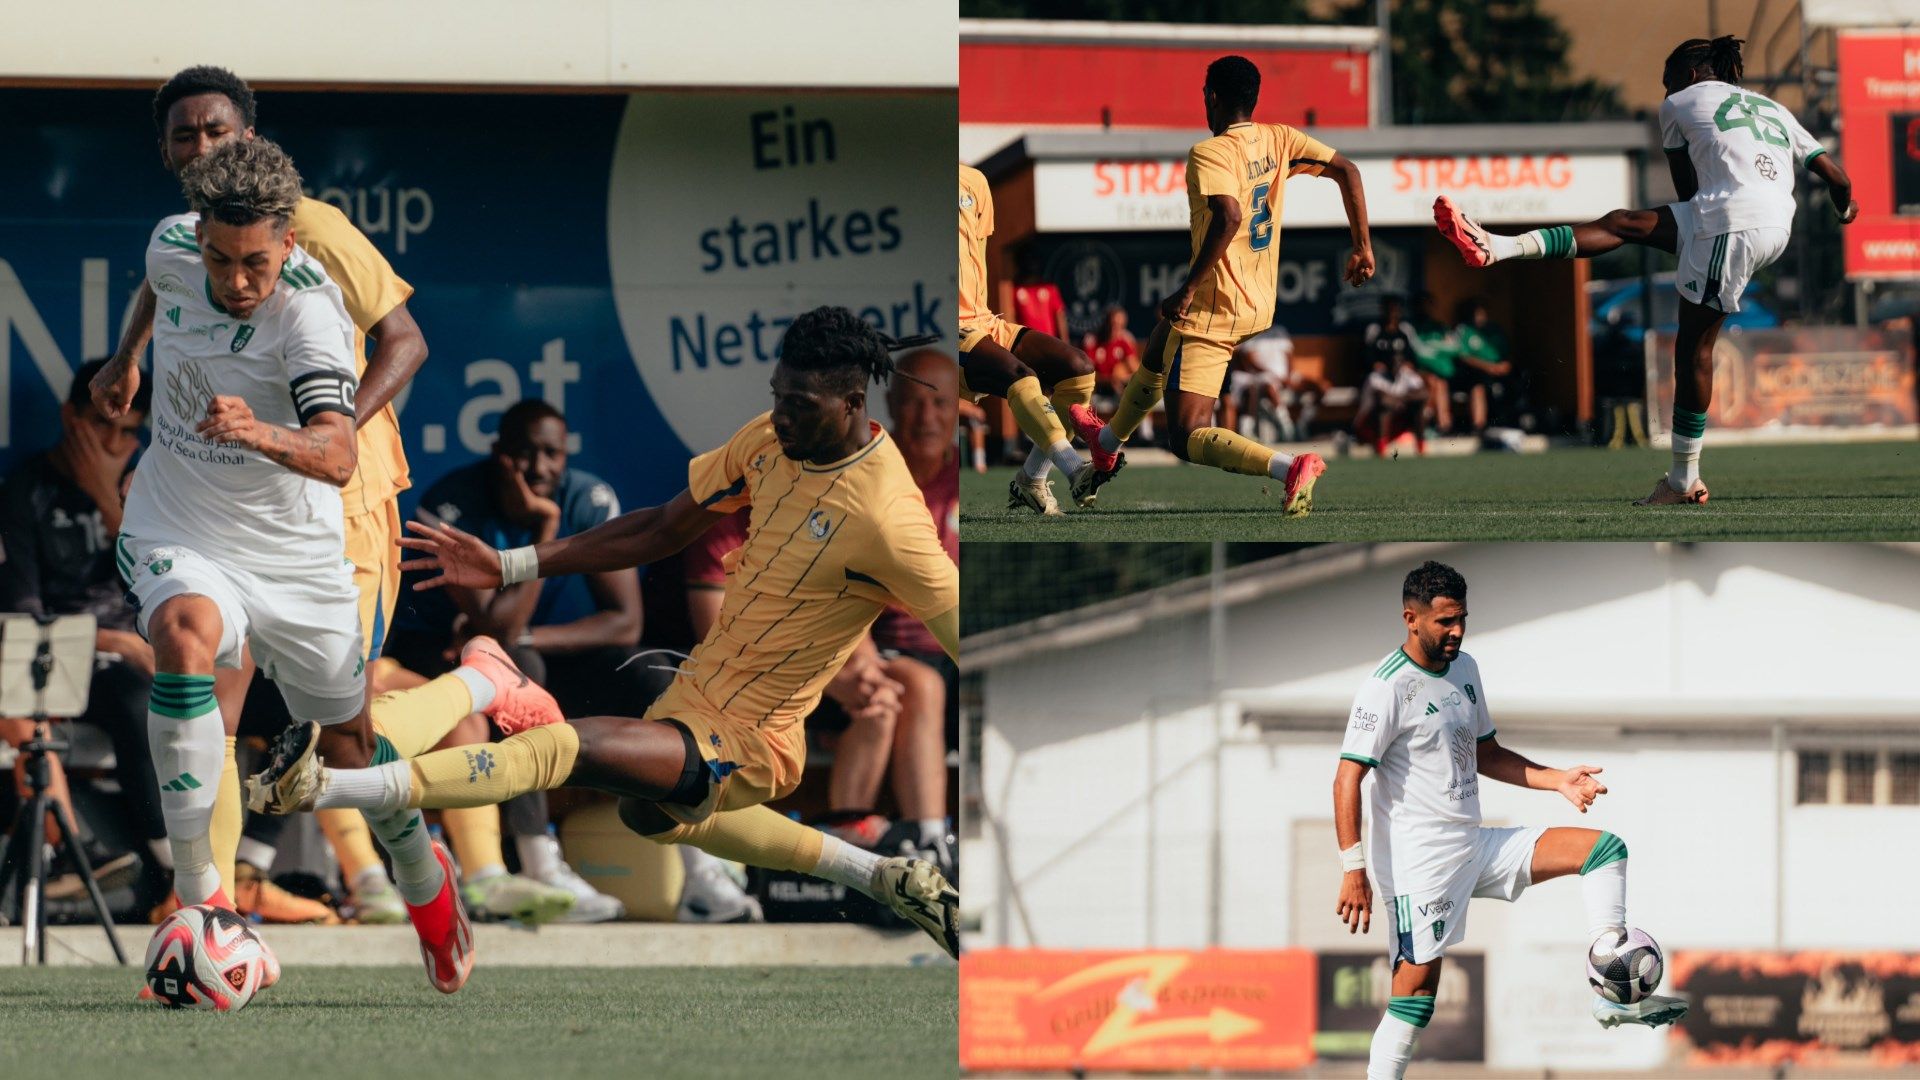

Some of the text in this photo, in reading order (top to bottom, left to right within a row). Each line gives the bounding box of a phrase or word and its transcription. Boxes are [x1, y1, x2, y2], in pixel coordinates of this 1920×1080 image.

[750, 105, 836, 170] Ein
[1713, 92, 1790, 149] 45
[1094, 159, 1187, 196] STRA
[1393, 153, 1574, 192] STRABAG
[302, 186, 434, 254] oup
[700, 198, 903, 273] starkes
[1248, 181, 1273, 252] 2
[668, 281, 946, 373] Netzerk
[174, 442, 196, 460] Sea
[199, 449, 245, 465] Global
